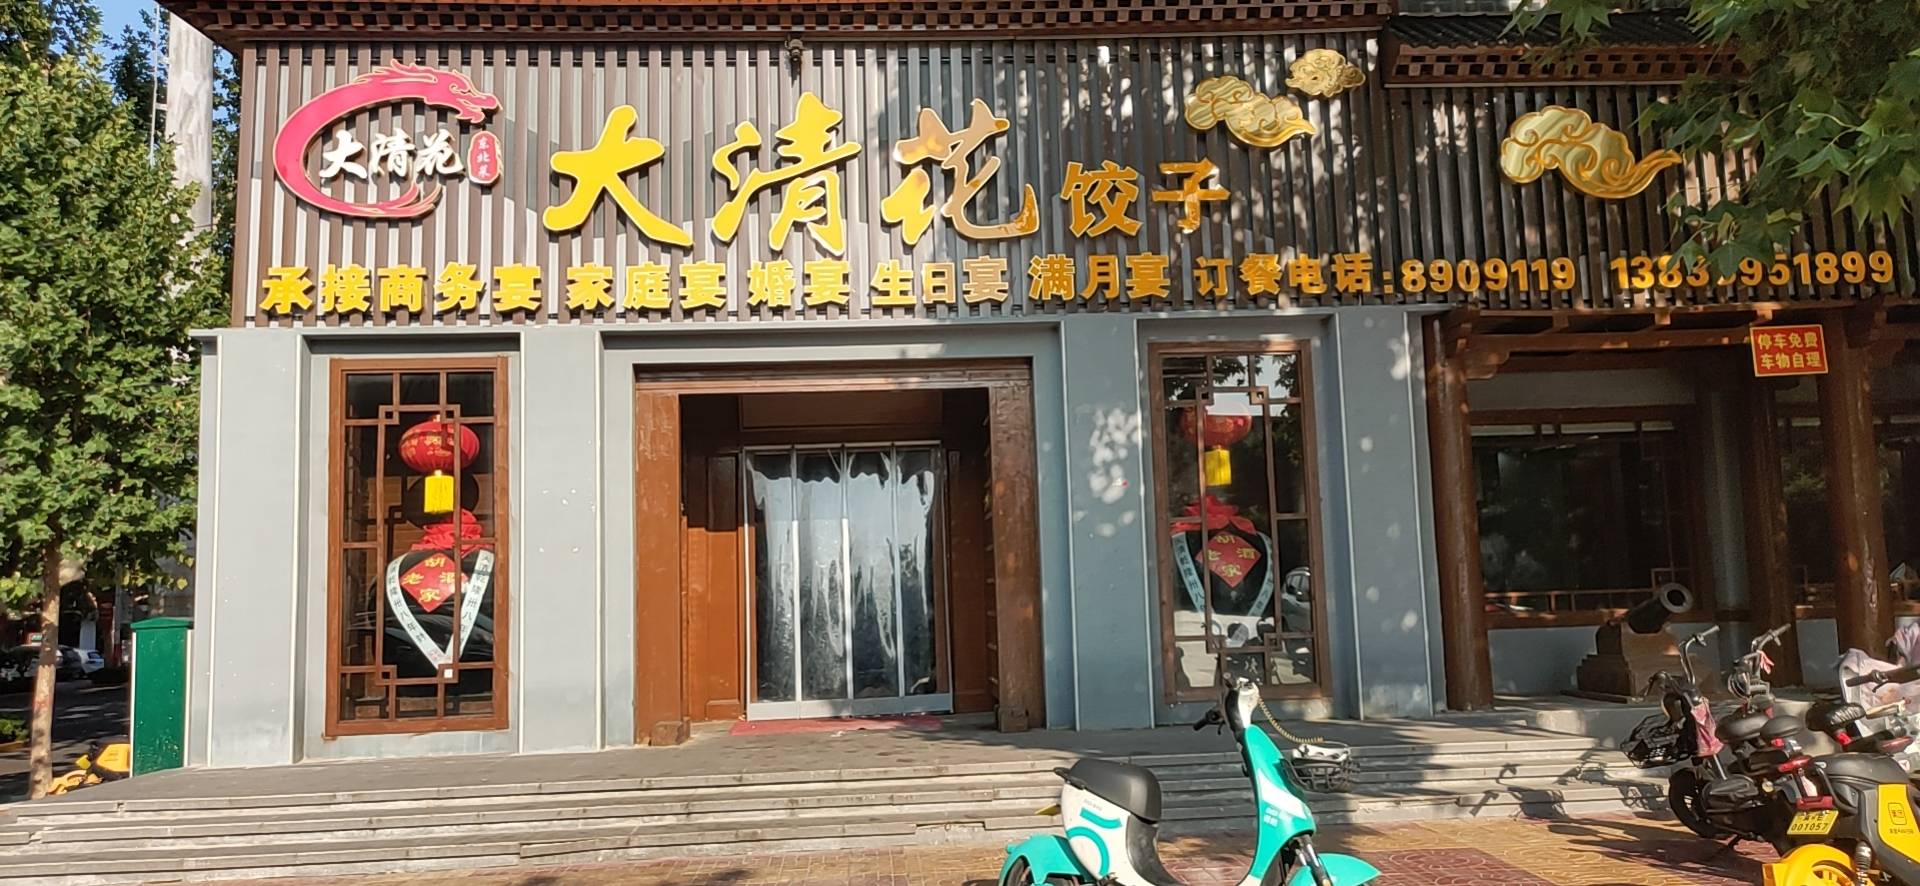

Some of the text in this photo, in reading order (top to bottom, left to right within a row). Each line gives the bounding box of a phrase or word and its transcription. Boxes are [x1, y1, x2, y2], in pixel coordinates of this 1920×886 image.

[318, 127, 464, 178] 大清花
[475, 136, 493, 178] 东北菜
[543, 91, 1231, 256] 大清花 饺子
[259, 261, 543, 315] 承接商务宴
[565, 261, 728, 310] 家庭宴
[747, 258, 850, 308] 婚宴
[870, 255, 1010, 306] 生日宴
[1028, 252, 1171, 301] 满月宴
[1610, 249, 1894, 290] 1383951899
[1757, 331, 1818, 350] 停车免费
[1760, 351, 1822, 370] 车物自理
[1790, 822, 1829, 831] 001057
